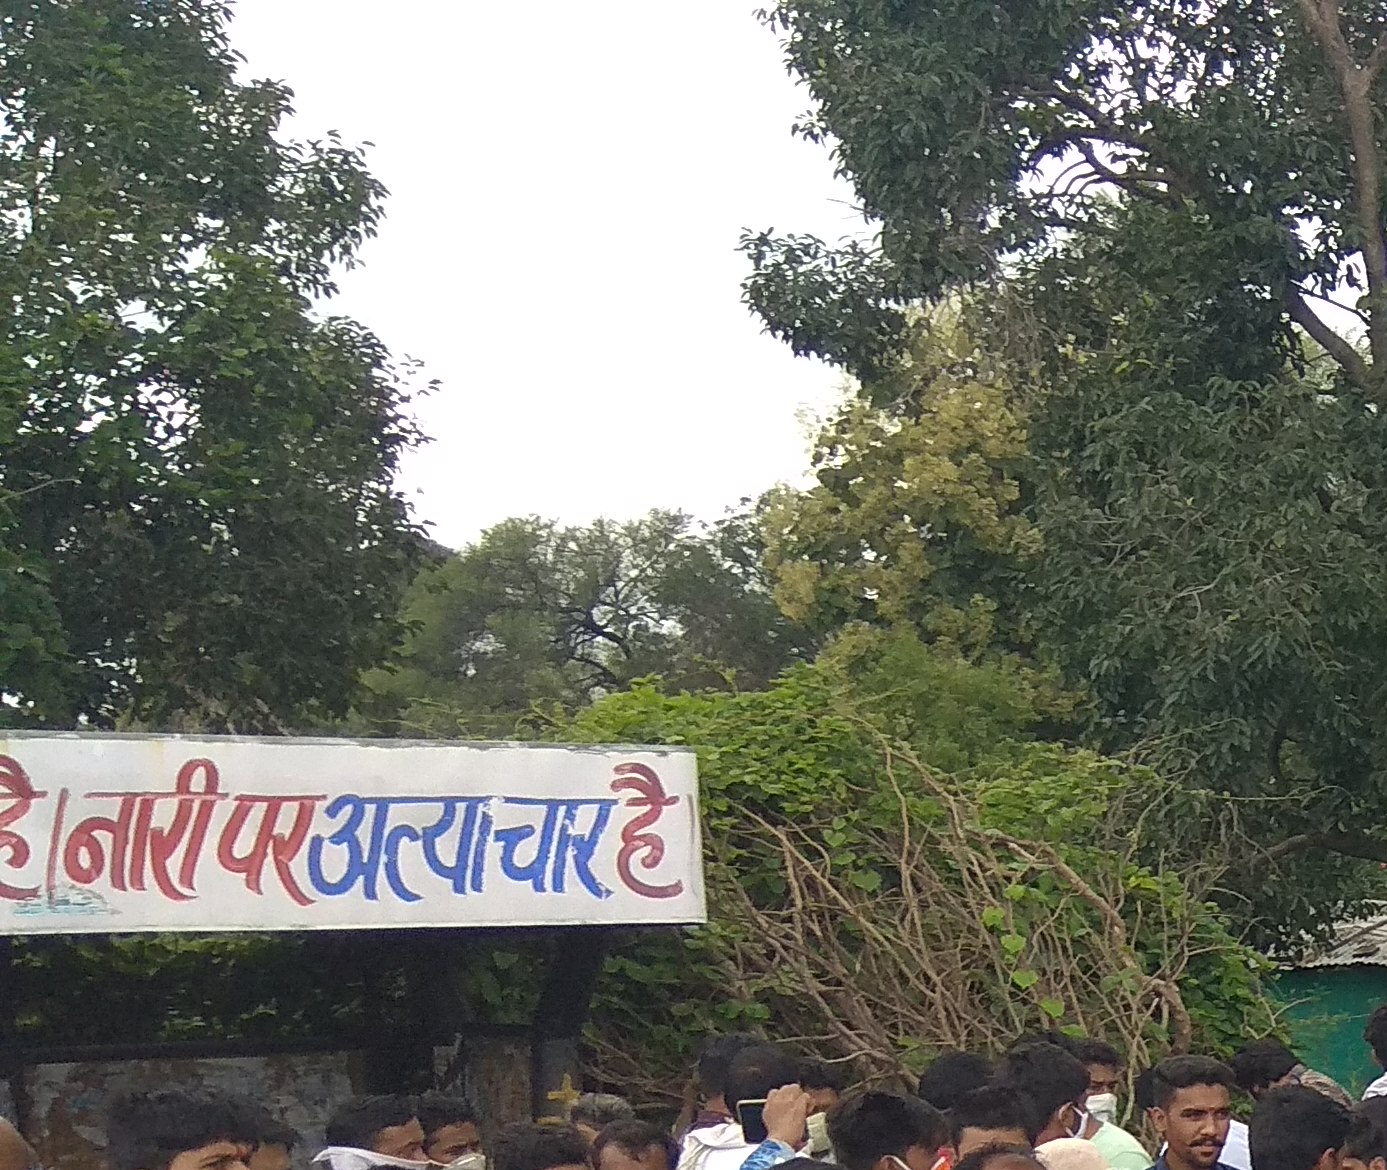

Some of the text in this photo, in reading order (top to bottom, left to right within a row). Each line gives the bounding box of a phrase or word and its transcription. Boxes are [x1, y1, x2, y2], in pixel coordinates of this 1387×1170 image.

[63, 757, 228, 903] नारी
[218, 793, 328, 906] पर
[308, 793, 619, 903] अत्याचार
